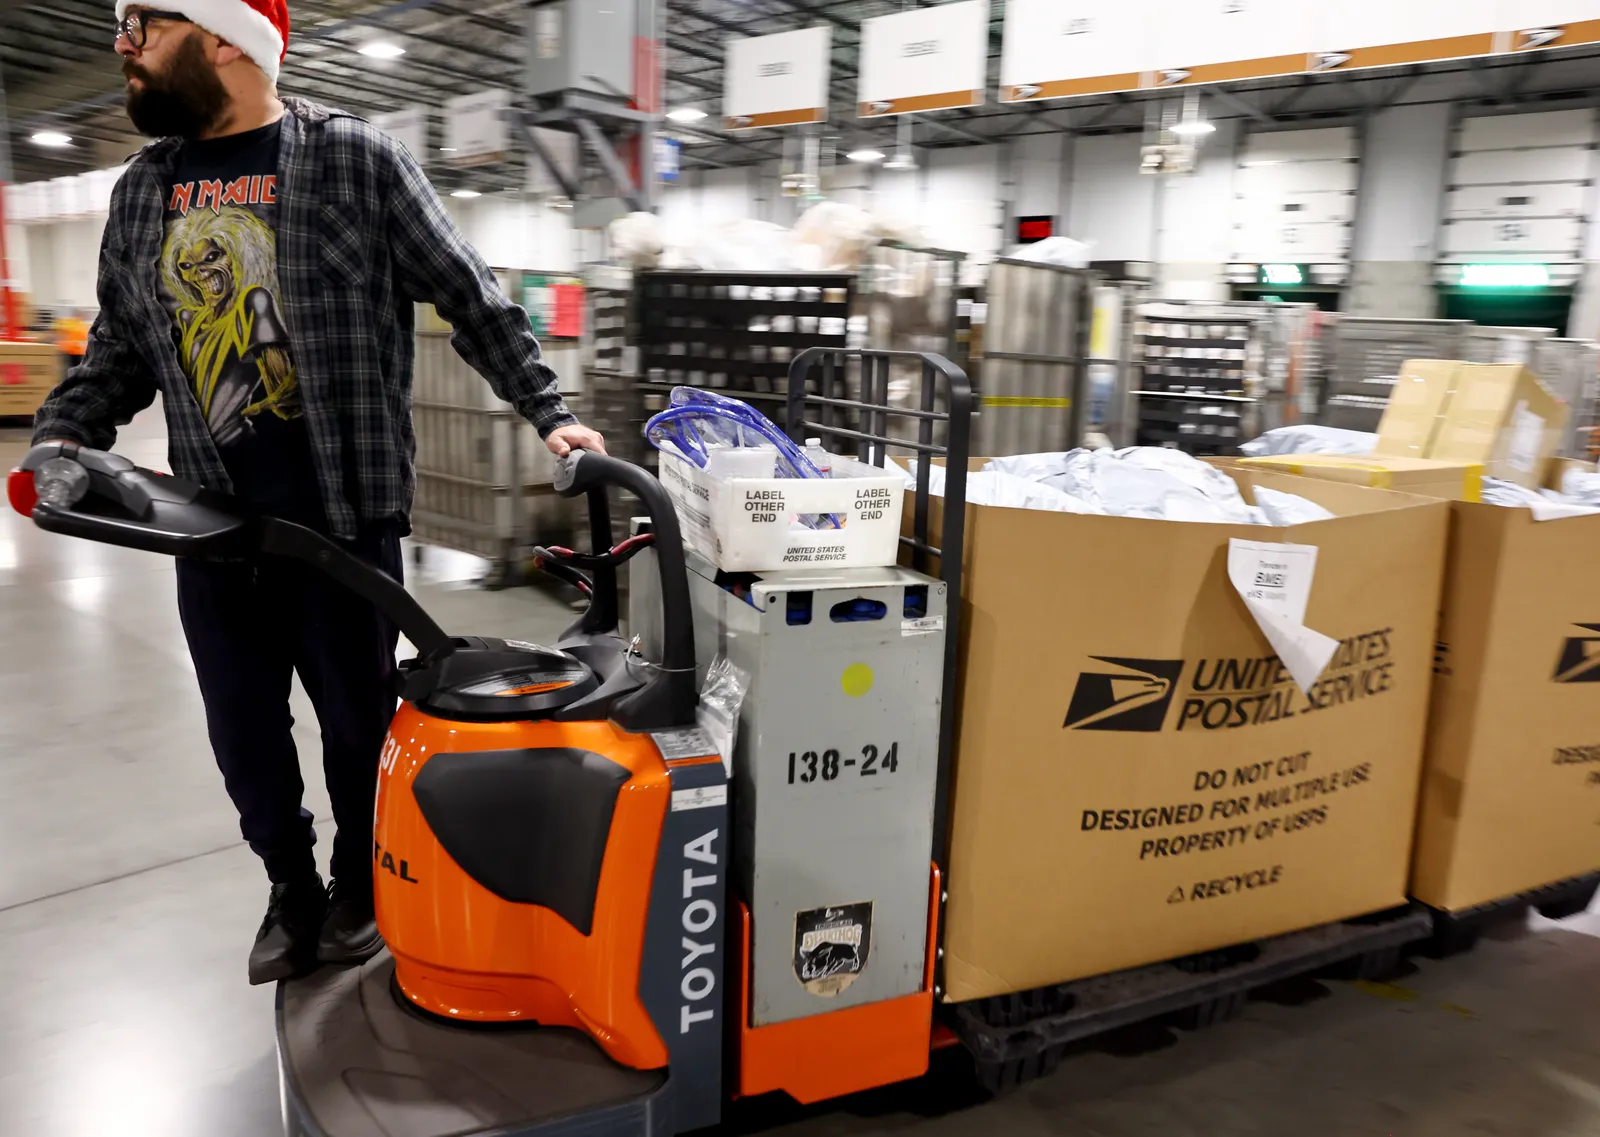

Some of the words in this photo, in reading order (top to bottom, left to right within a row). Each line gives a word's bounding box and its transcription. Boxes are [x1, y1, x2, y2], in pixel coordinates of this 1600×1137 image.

[744, 501, 785, 511] OTHER
[746, 490, 785, 500] LABEL
[854, 499, 891, 510] OTHER
[856, 488, 891, 499] LABEL
[752, 513, 777, 523] END
[860, 510, 883, 521] END
[815, 553, 847, 562] SERVICE
[1192, 655, 1296, 692] UNITE
[1176, 687, 1295, 731] POSTAL
[1300, 662, 1395, 713] SERVICE
[787, 741, 899, 785] 138-24
[1193, 769, 1227, 791] DO
[1232, 760, 1274, 788] NOT
[1275, 750, 1312, 777] CUT
[1080, 803, 1204, 831] DESIGNED
[1209, 796, 1251, 820] FOR
[1253, 772, 1340, 811] MULTIPLE
[1342, 762, 1373, 788] USE
[1139, 824, 1252, 860] PROPERTY
[1254, 818, 1280, 840] OF
[1283, 805, 1329, 833] USPS
[1190, 864, 1284, 901] RECYCLE
[680, 828, 719, 1034] TOYOTA
